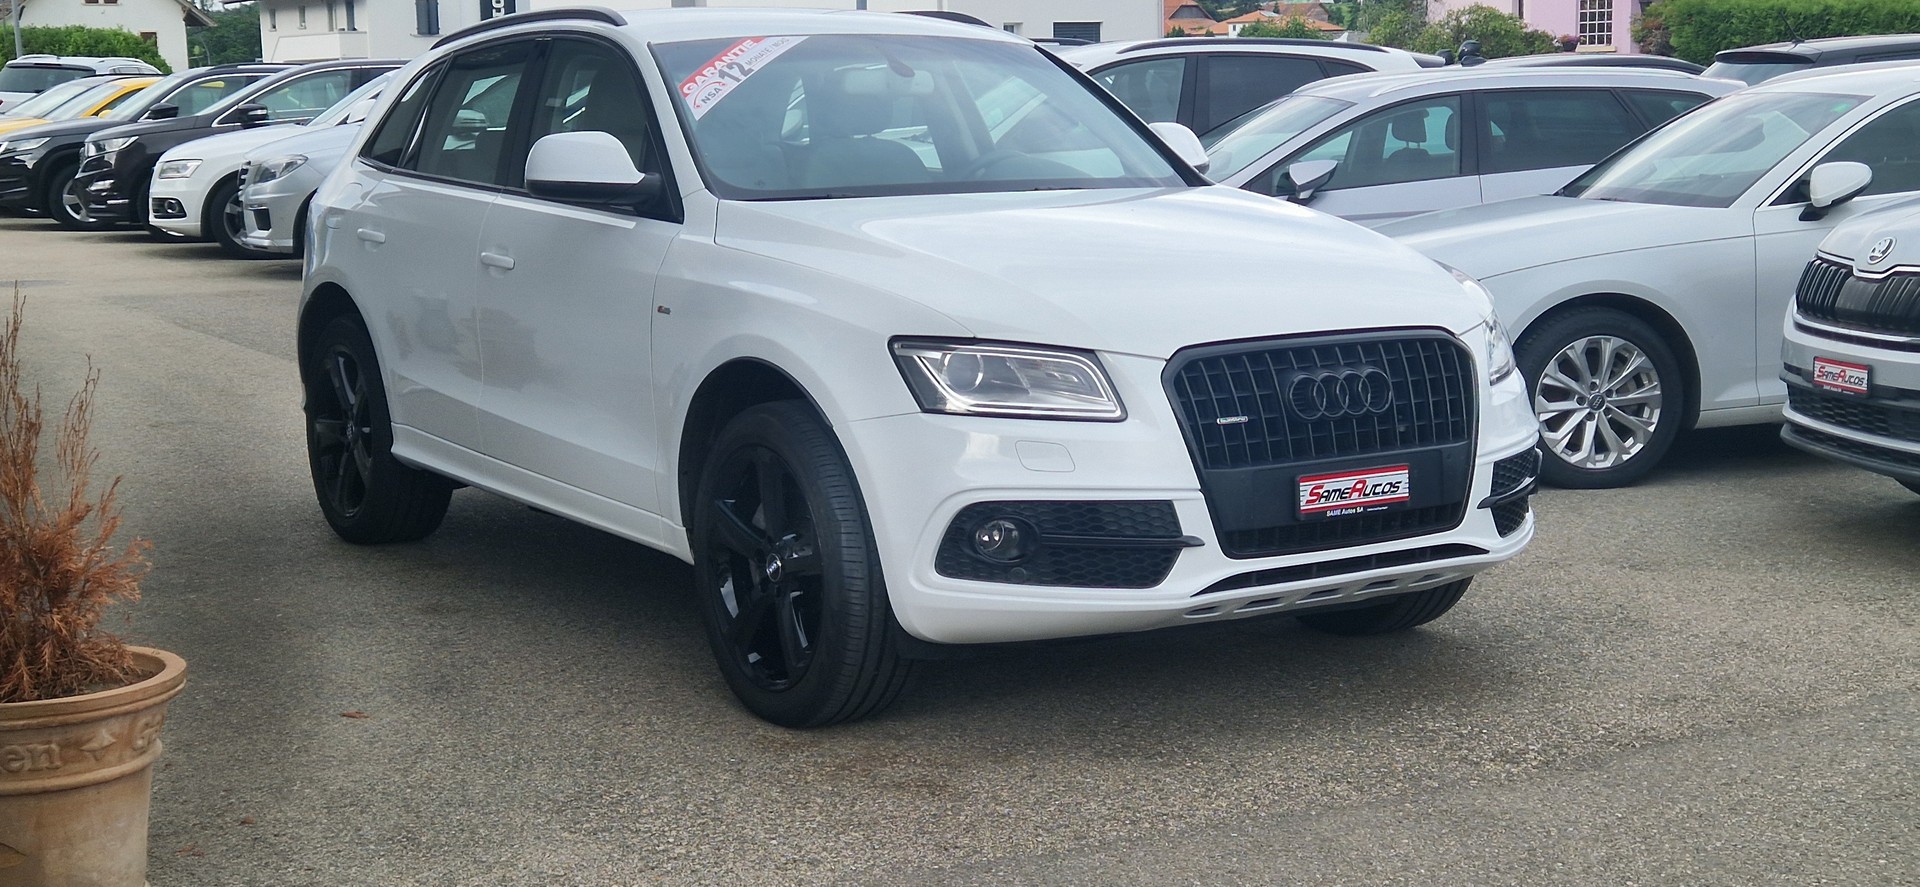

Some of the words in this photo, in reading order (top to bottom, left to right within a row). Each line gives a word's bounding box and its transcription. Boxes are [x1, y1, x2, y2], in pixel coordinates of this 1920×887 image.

[682, 39, 758, 95] GARANTIE
[718, 61, 755, 83] 12
[701, 87, 723, 104] NSA
